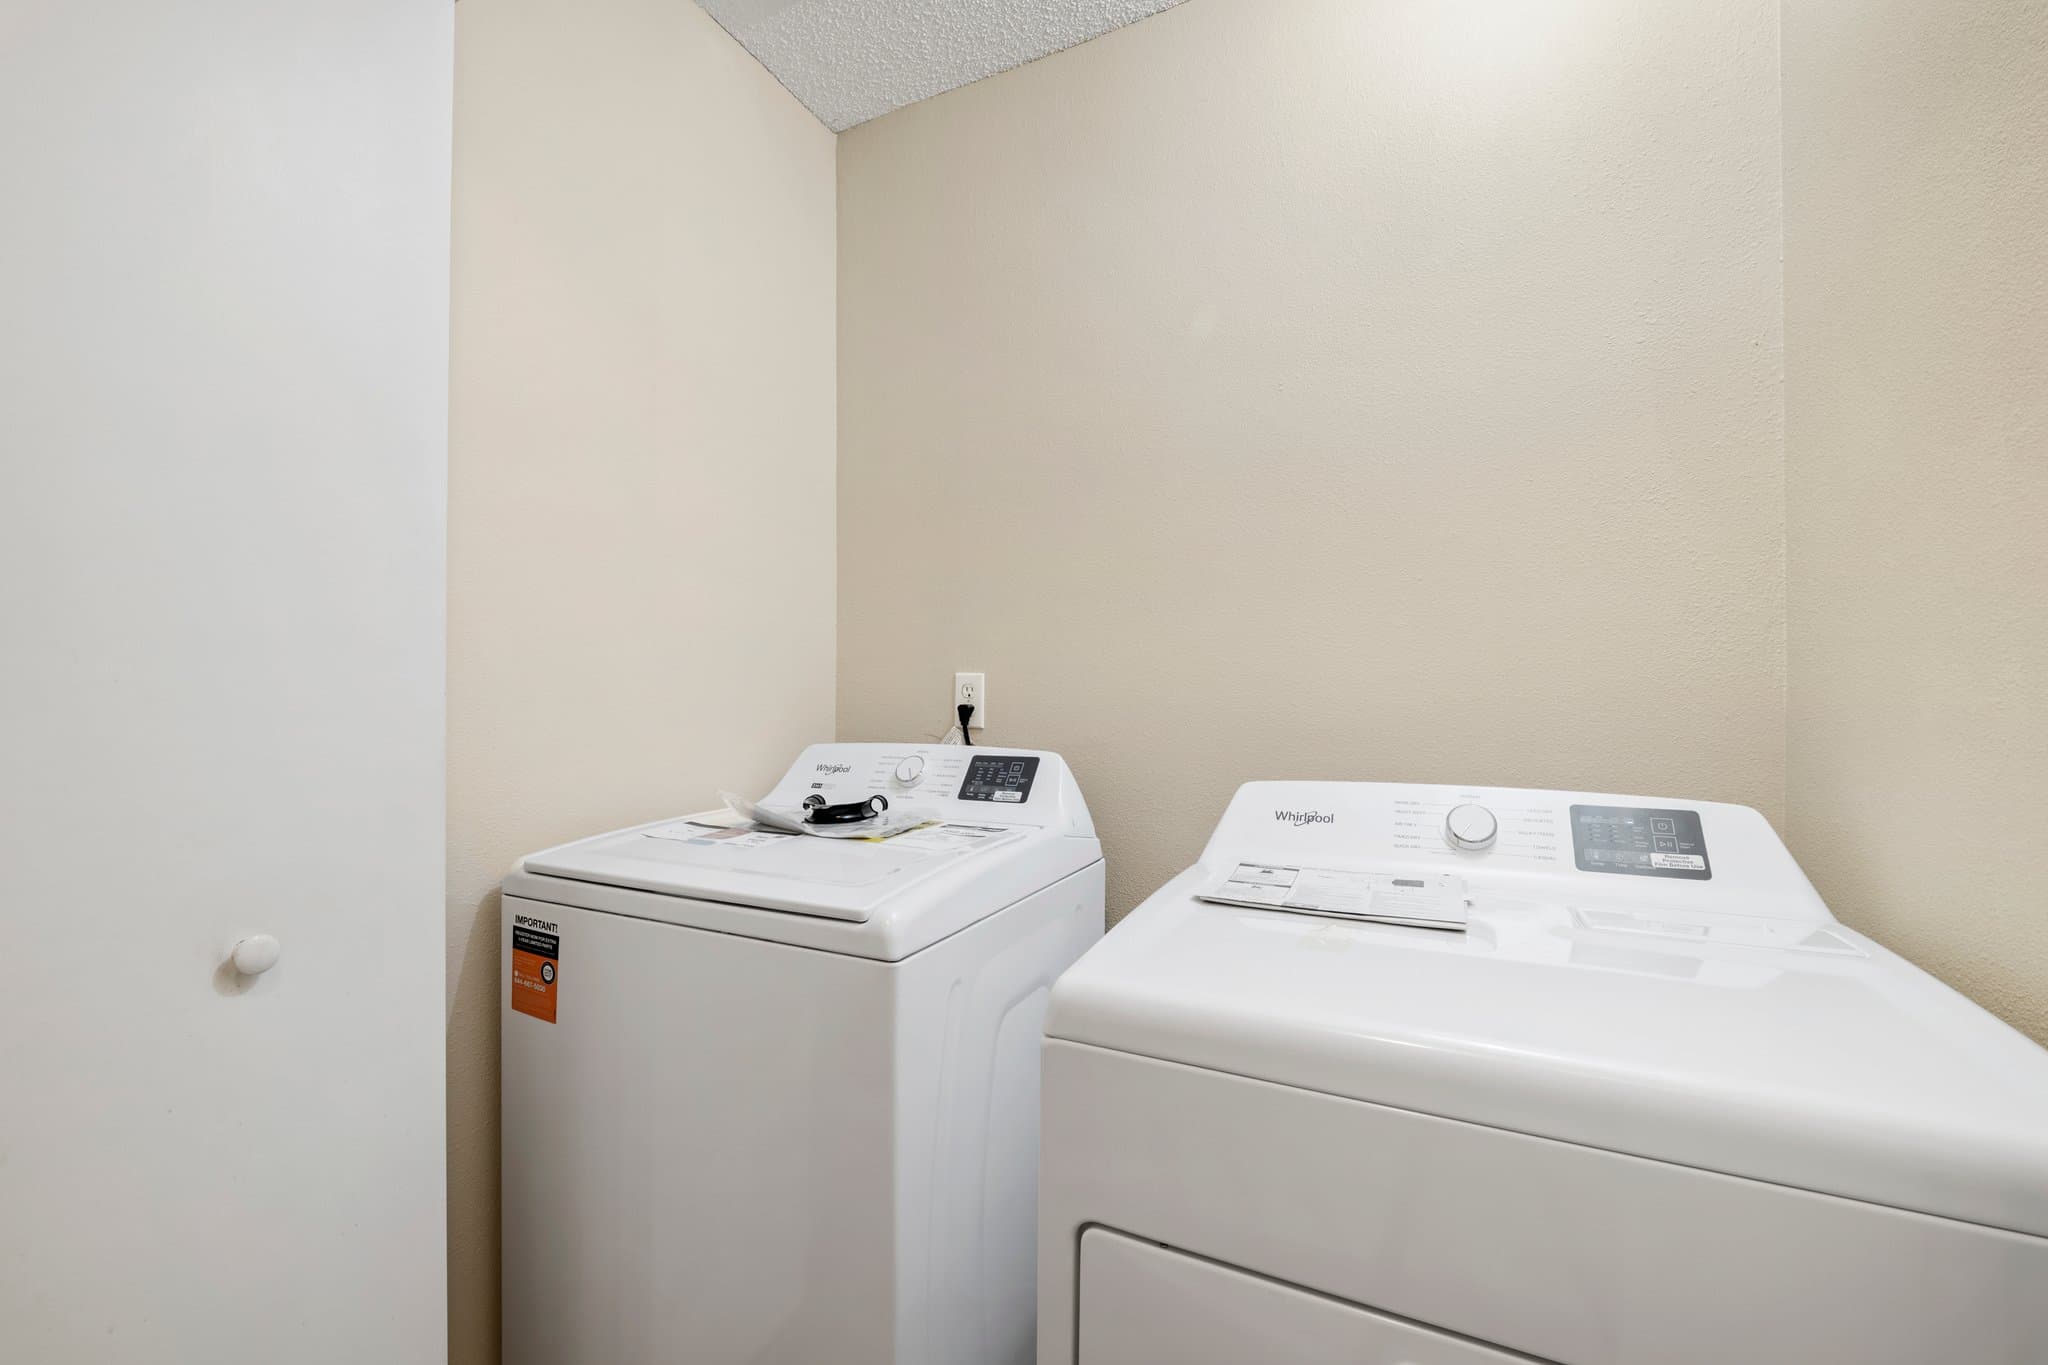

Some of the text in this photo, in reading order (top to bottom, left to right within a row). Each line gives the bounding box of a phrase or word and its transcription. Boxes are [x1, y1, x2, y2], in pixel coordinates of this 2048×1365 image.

[816, 763, 851, 776] Whirlpool
[1275, 810, 1335, 827] Whirlpool
[515, 914, 558, 933] IMPORTANT!
